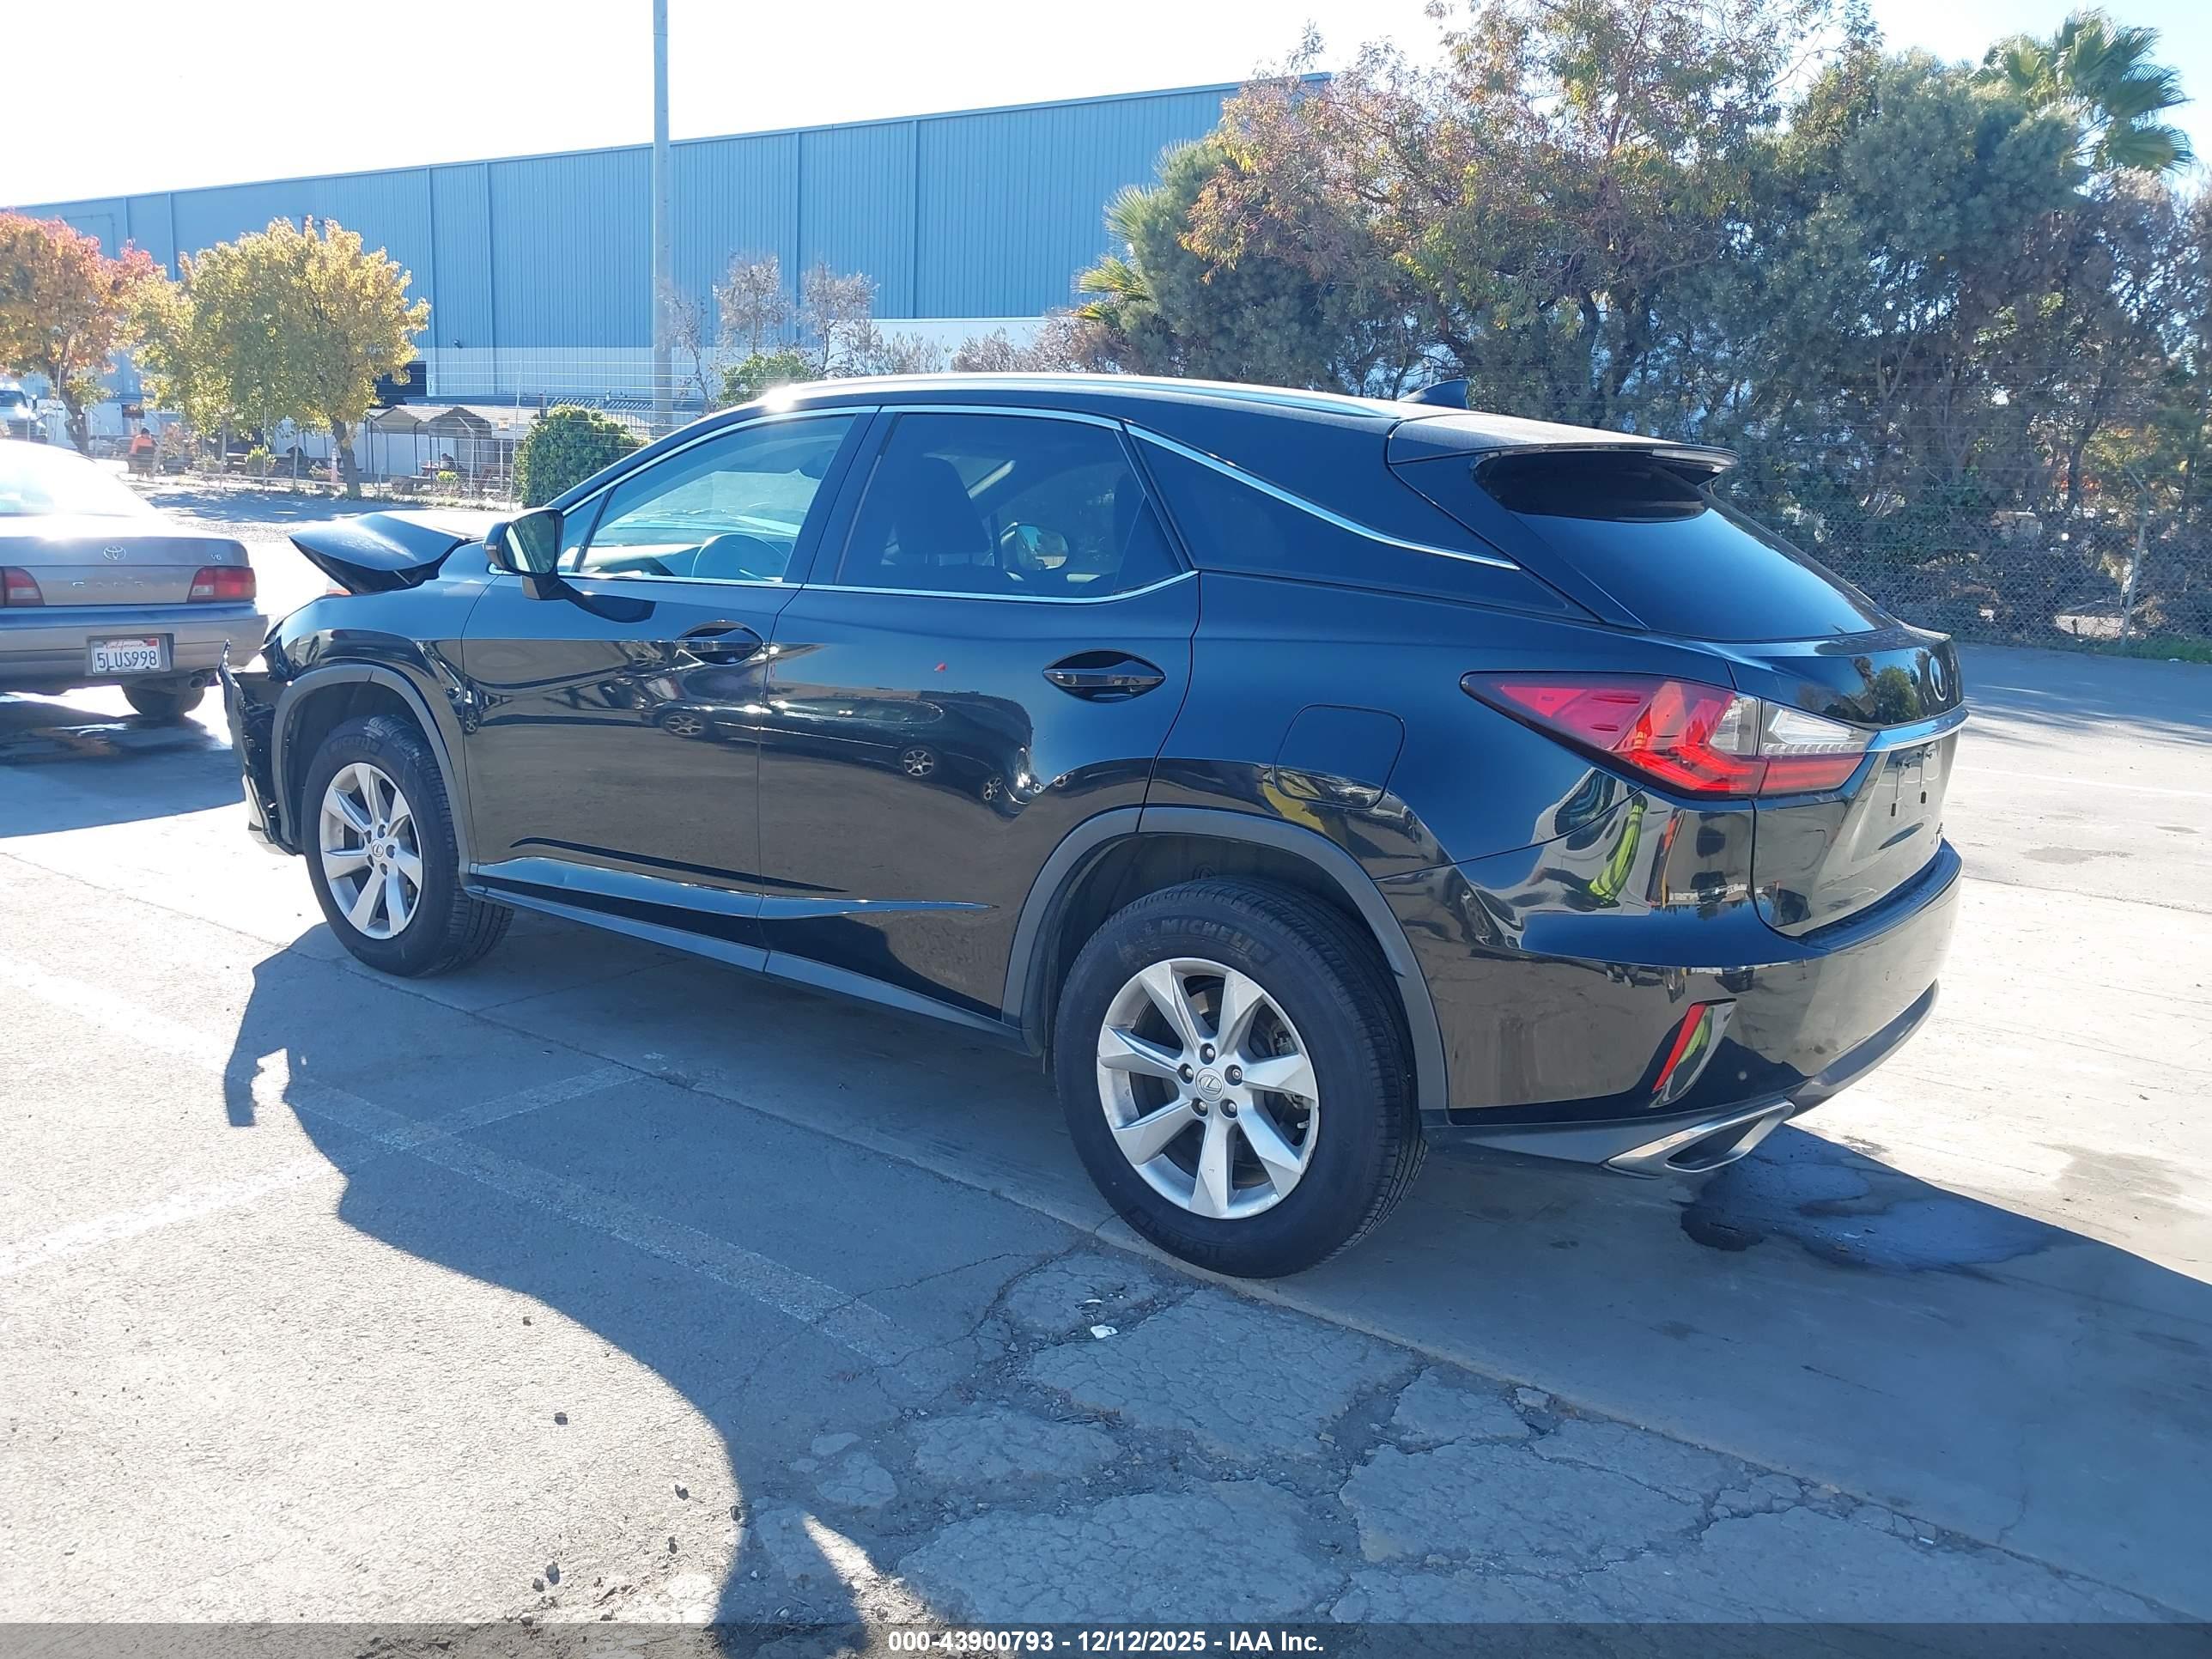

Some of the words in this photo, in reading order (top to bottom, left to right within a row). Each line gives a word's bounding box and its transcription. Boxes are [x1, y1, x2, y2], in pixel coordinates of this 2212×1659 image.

[106, 640, 144, 651] California
[97, 650, 157, 669] 5LUS998
[1160, 919, 1272, 964] MICHELIN
